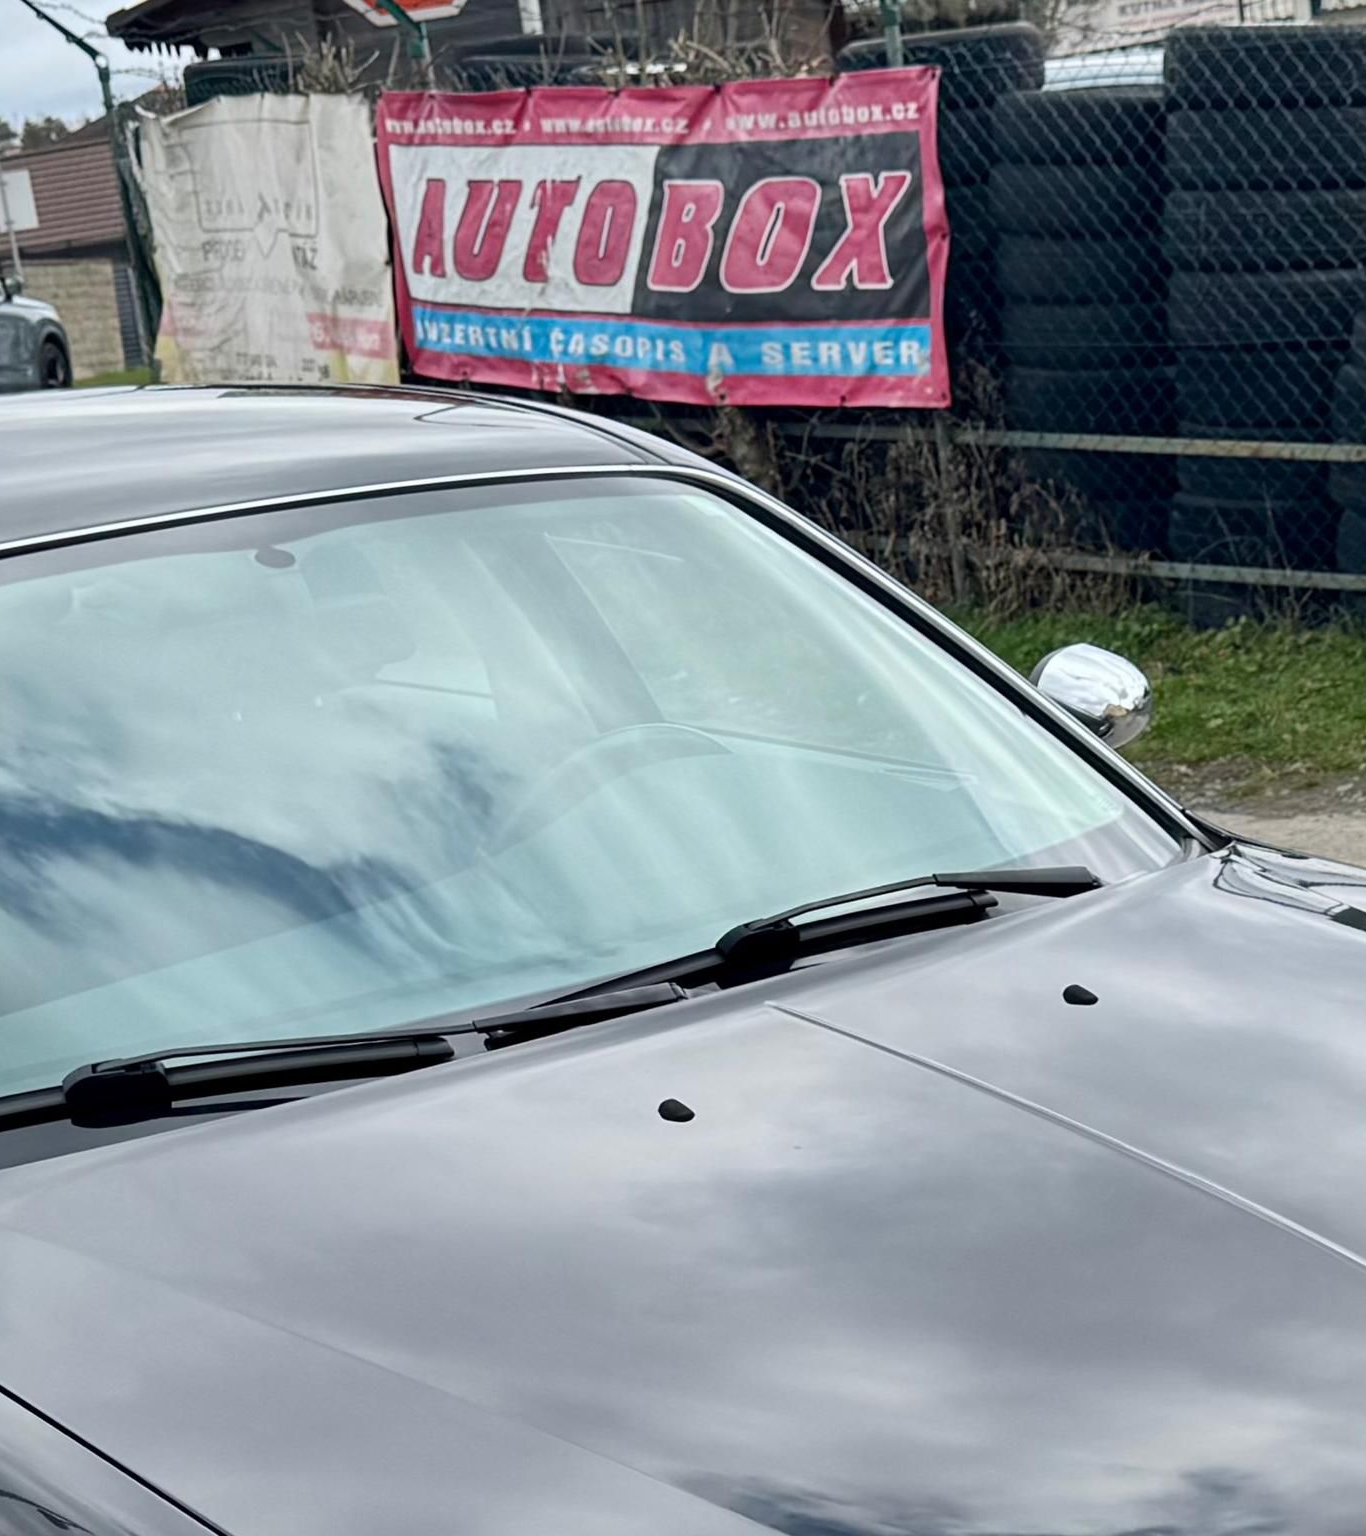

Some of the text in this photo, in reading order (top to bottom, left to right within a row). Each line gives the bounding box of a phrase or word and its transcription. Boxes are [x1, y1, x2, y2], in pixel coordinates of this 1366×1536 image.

[411, 170, 913, 293] AUTOBOX
[708, 341, 733, 369] A
[761, 340, 921, 367] SERVER
